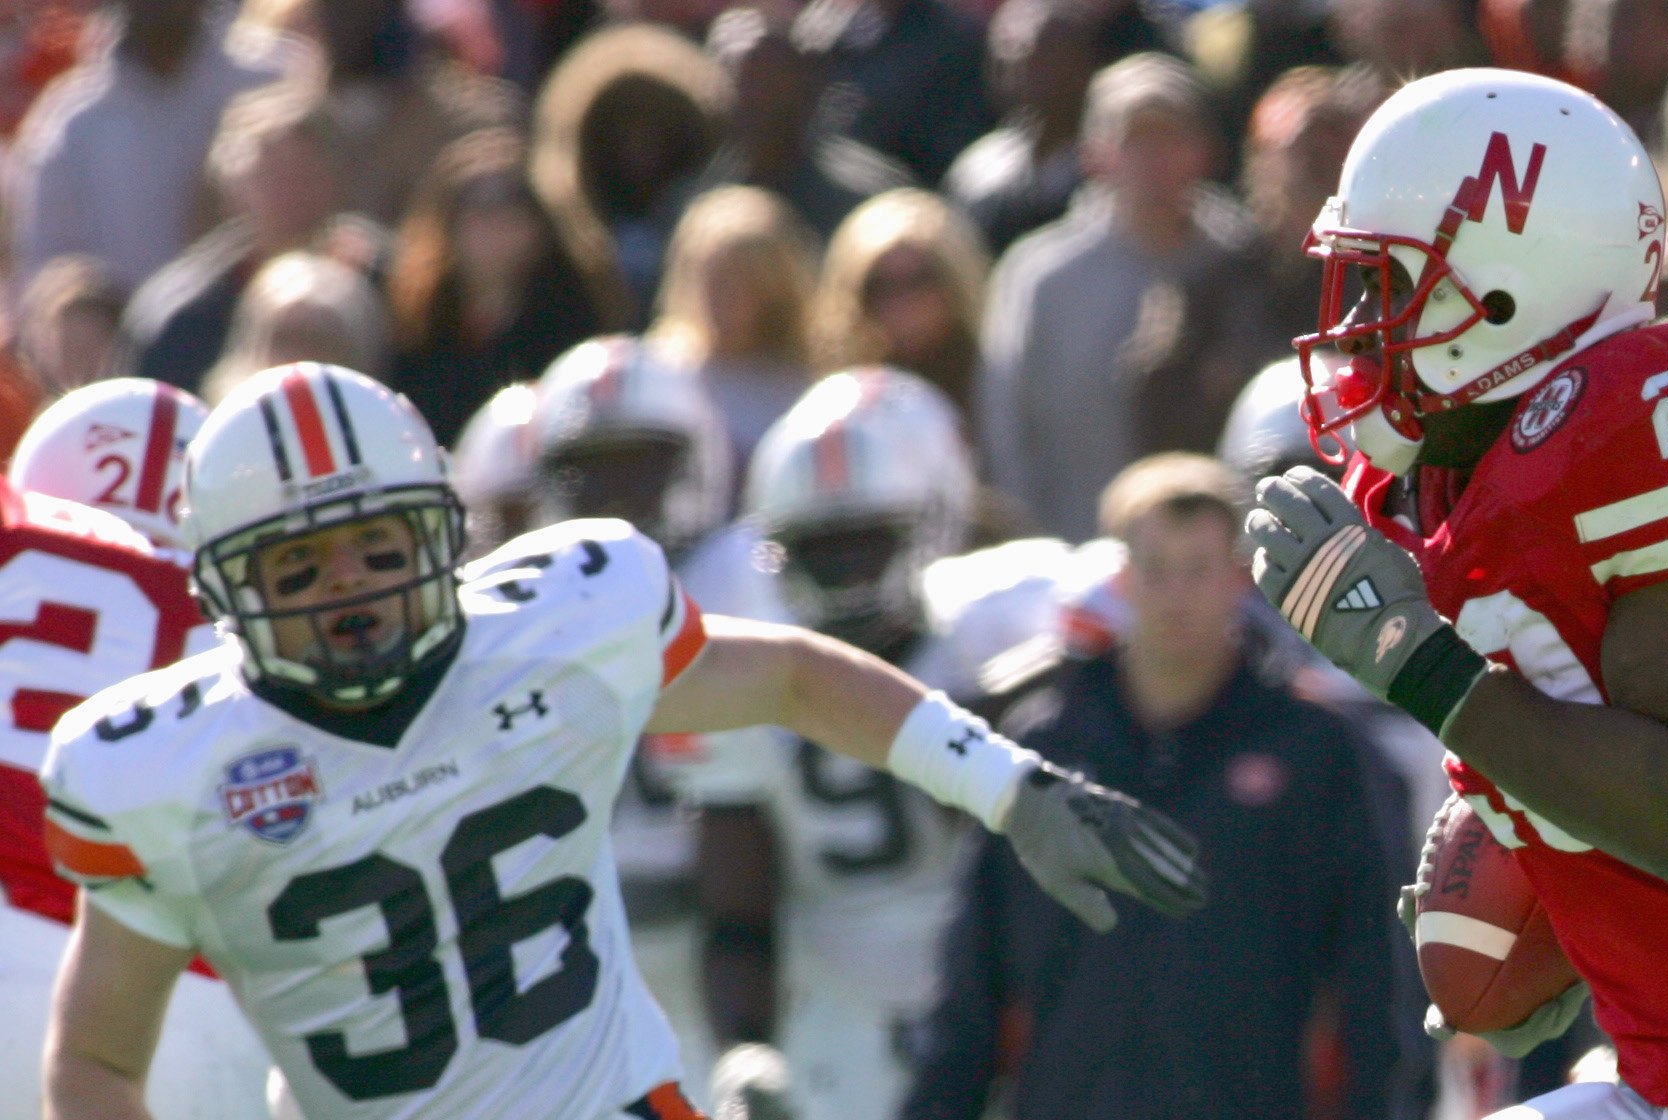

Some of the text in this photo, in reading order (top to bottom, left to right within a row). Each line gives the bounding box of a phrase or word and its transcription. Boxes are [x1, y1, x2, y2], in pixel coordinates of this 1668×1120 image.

[1464, 130, 1547, 235] N
[351, 758, 460, 816] AUBURN
[266, 784, 600, 1103] 36
